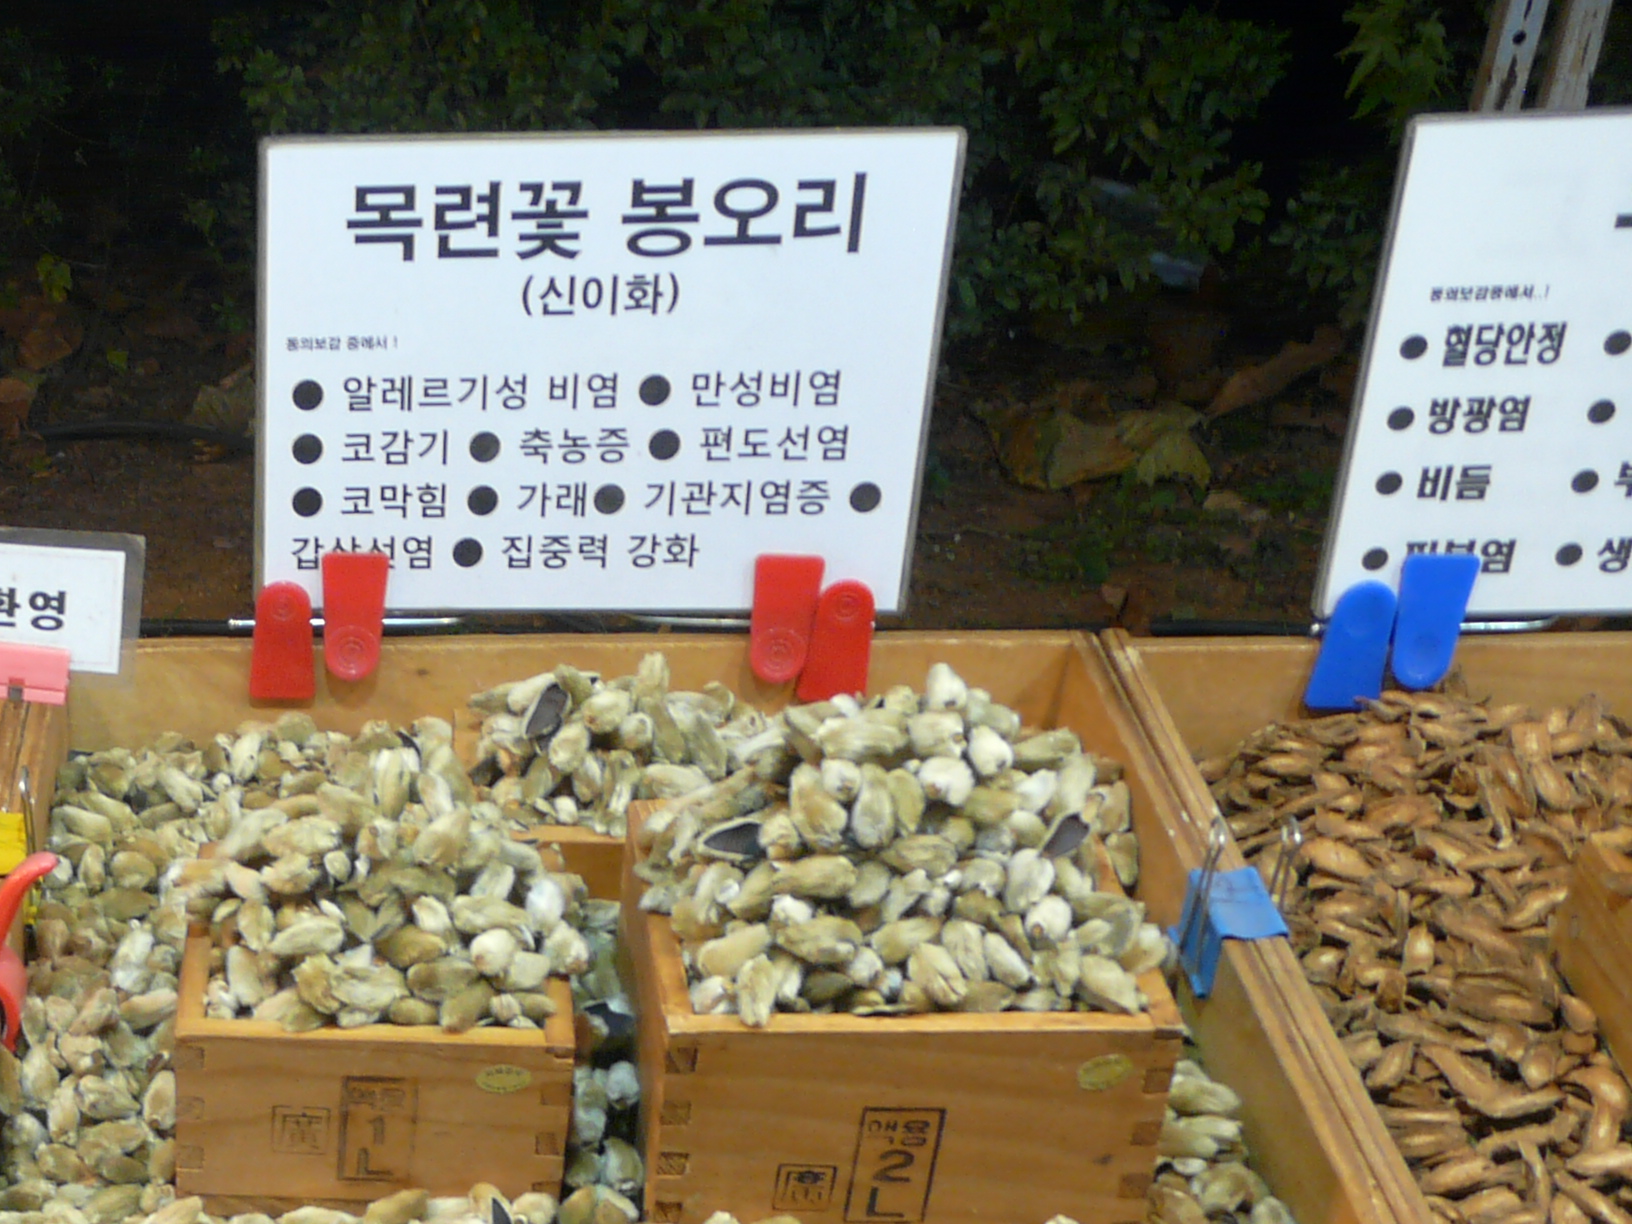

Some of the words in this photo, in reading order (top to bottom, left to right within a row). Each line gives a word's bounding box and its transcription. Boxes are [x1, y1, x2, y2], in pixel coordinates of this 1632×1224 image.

[346, 181, 589, 262] 목련꽃
[621, 172, 867, 258] 봉오리
[522, 272, 679, 316] (신이화)
[1442, 321, 1568, 367] 혈당안정
[343, 373, 527, 412] 알레르기성
[549, 372, 618, 410] 비염
[692, 369, 841, 407] 만성비염
[1428, 395, 1531, 435] 방광염
[341, 429, 448, 466] 코감기
[519, 427, 629, 465] 축농증
[700, 425, 849, 462] 편도선염
[341, 483, 446, 519] 코막힘
[518, 481, 587, 518] 가래
[645, 479, 830, 517] 기관지염증
[1417, 465, 1492, 501] 비듬
[502, 534, 608, 570] 집중력
[628, 533, 699, 569] 강화
